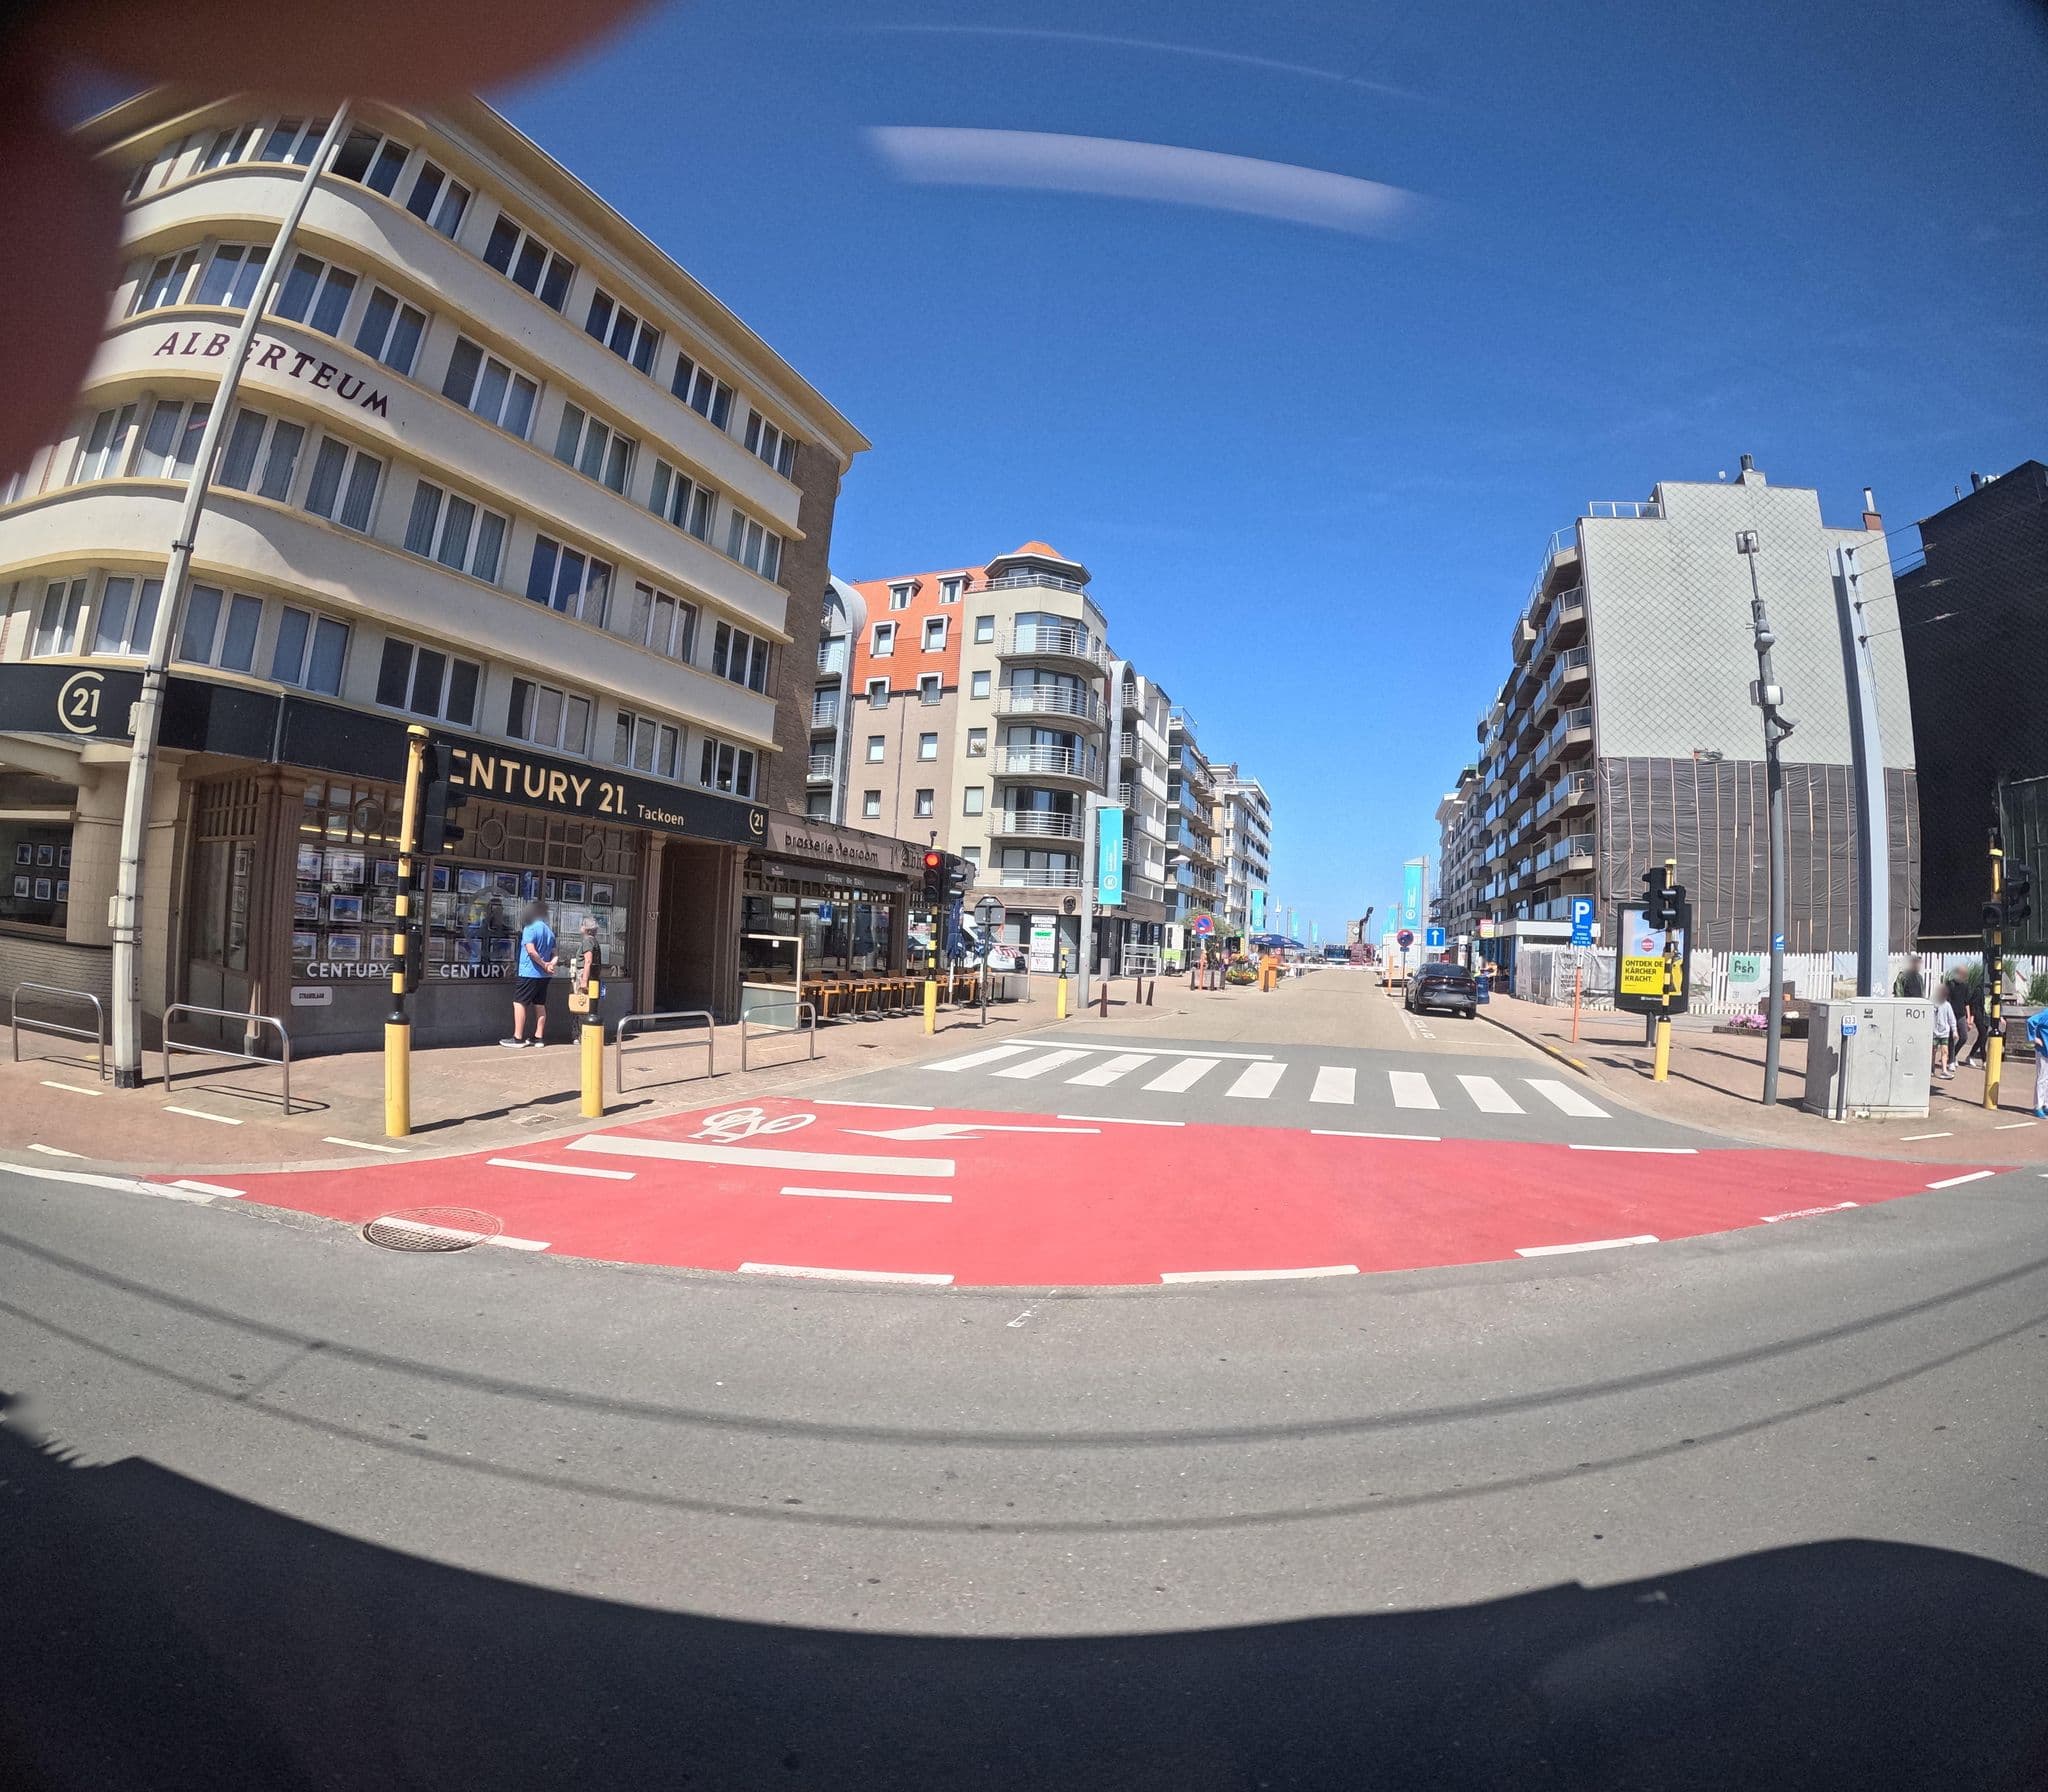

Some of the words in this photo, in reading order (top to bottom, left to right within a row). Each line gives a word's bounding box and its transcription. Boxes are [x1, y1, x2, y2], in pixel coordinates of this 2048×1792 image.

[421, 749, 591, 807] ENTURY
[637, 804, 684, 826] Tackoen
[785, 831, 833, 853] brasserie
[1575, 901, 1590, 924] P
[440, 964, 511, 979] CENTURY
